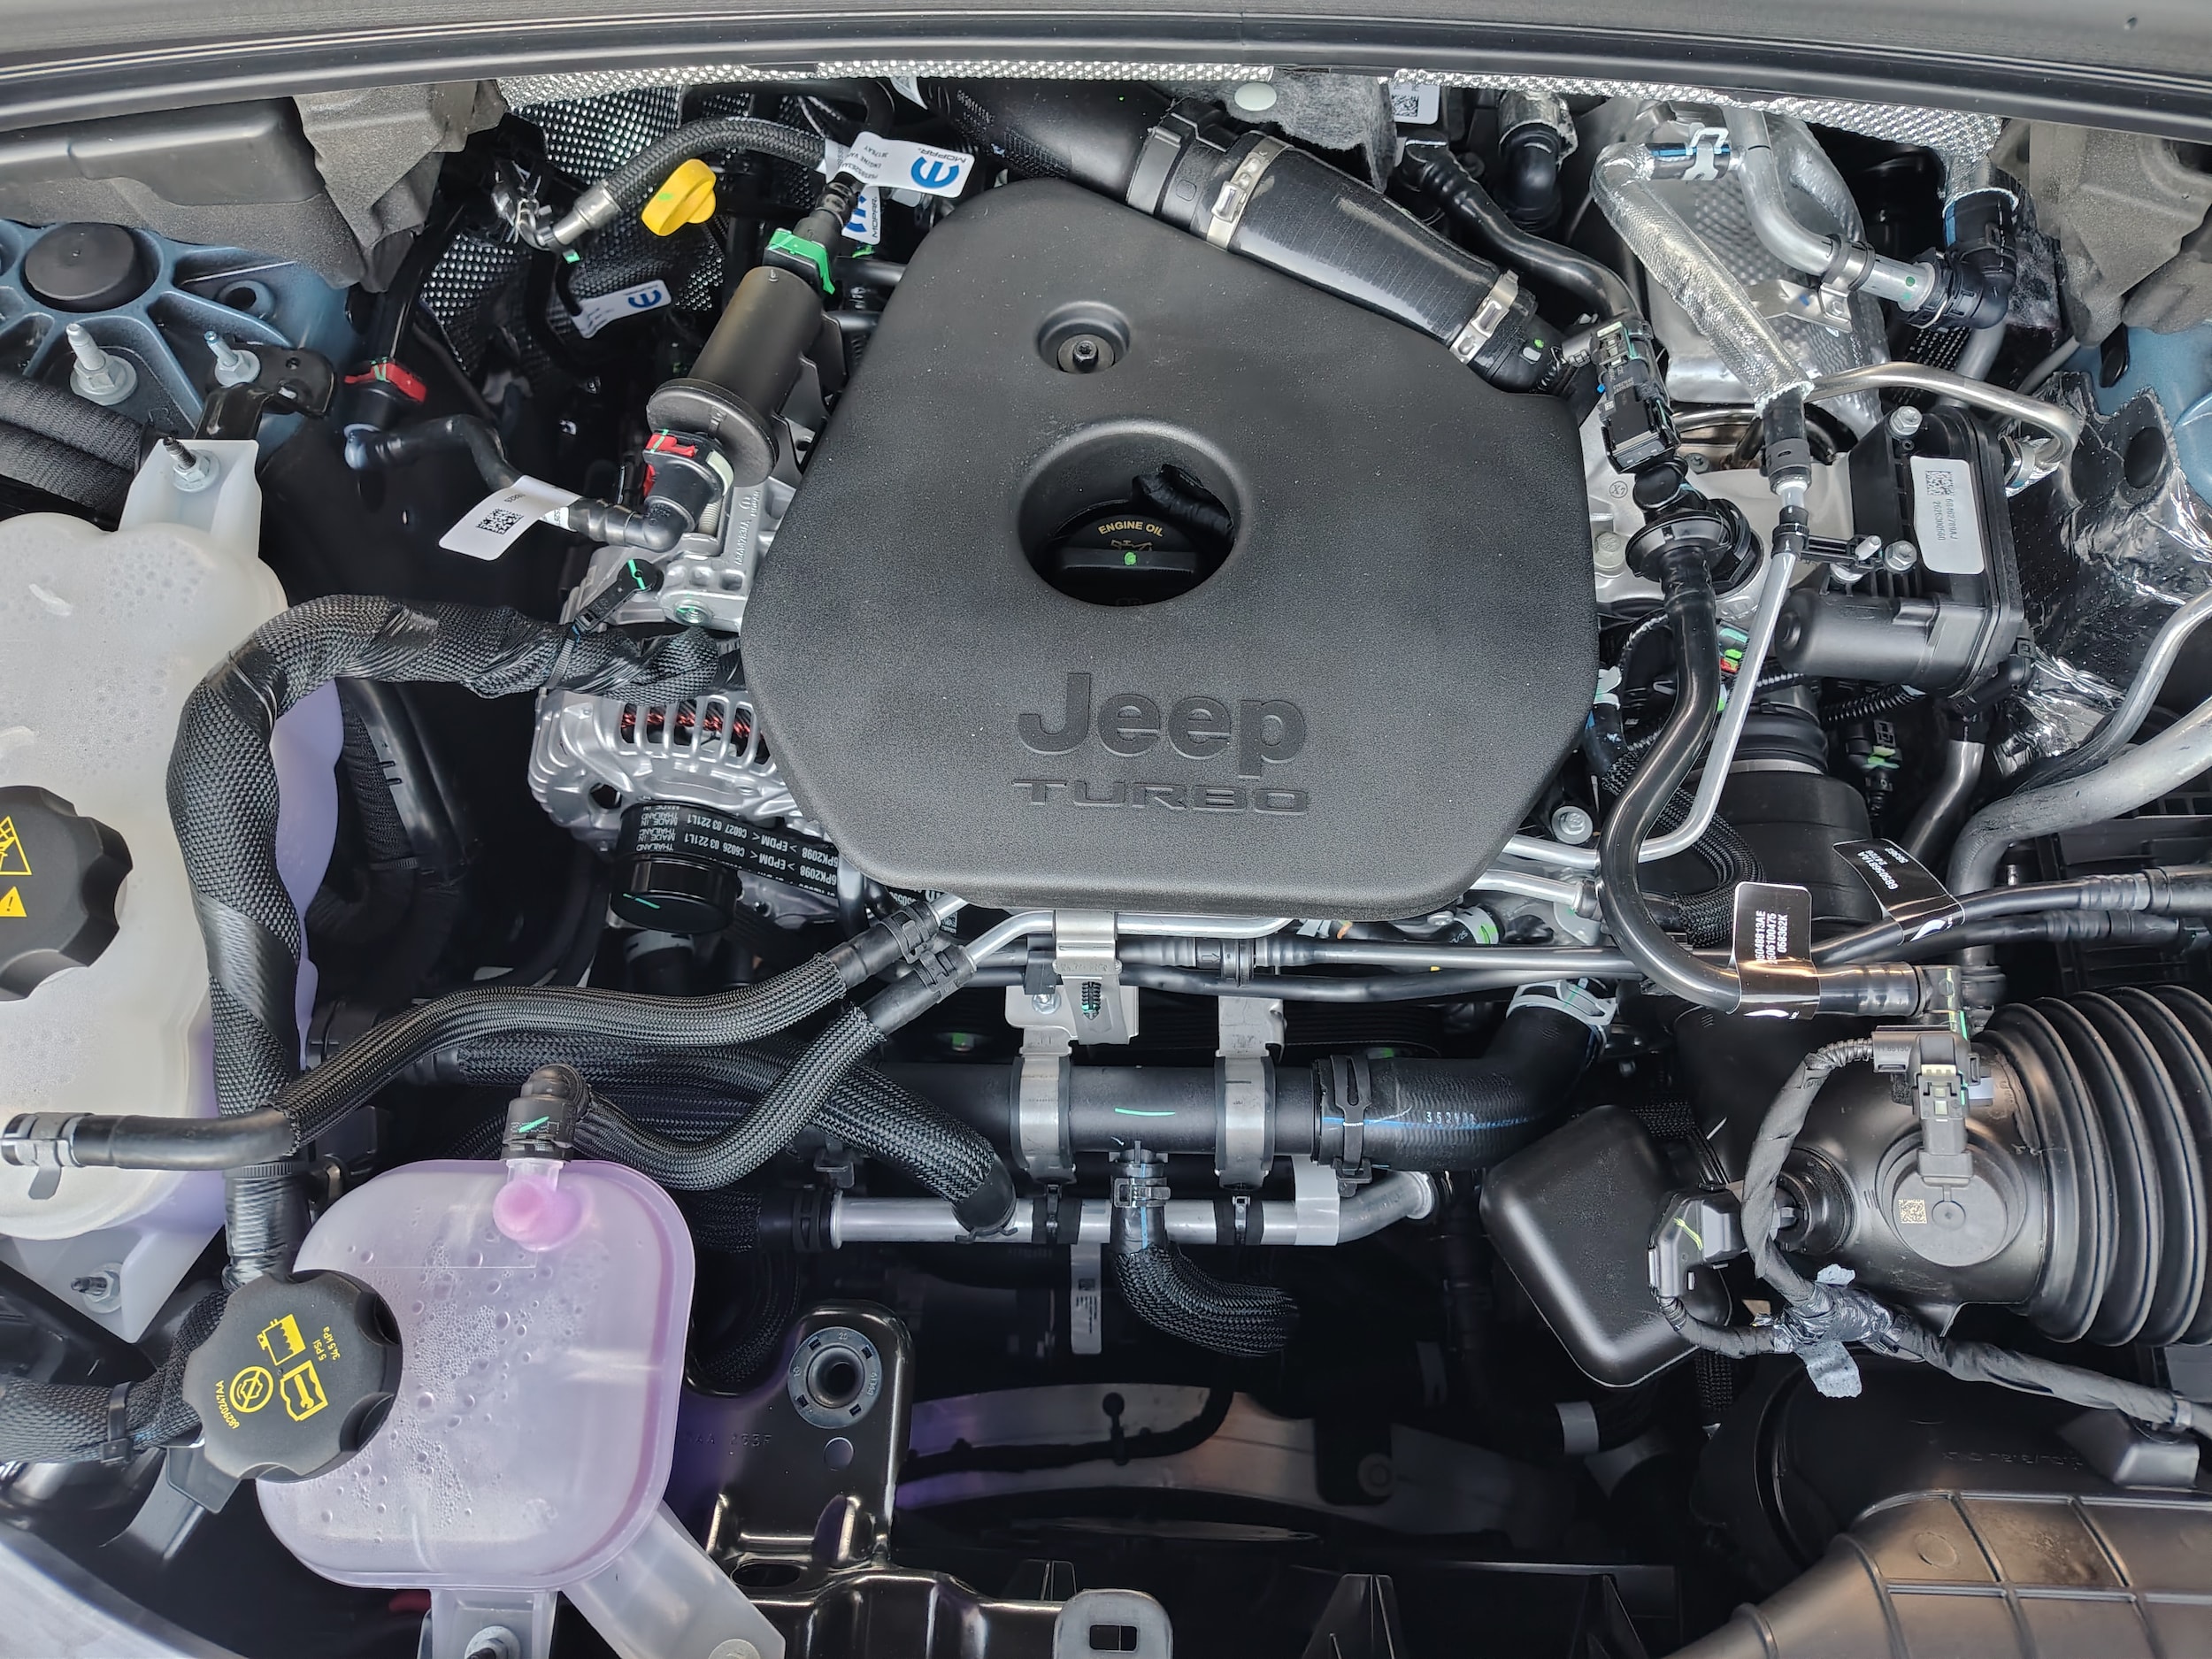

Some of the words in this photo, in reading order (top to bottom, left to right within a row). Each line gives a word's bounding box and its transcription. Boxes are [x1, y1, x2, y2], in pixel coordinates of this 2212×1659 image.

[1098, 520, 1143, 534] ENGINE
[1145, 524, 1164, 537] OIL
[1018, 672, 1306, 779] Jeep
[1012, 778, 1309, 815] TURBO
[650, 833, 676, 842] MADE
[725, 824, 748, 839] C6027
[722, 841, 745, 857] C6026
[802, 847, 839, 868] 6PK2098
[799, 864, 837, 887] 6PK2098
[323, 1326, 335, 1344] kPa
[312, 1339, 326, 1354] PSI
[327, 1343, 341, 1361] 34.5
[318, 1353, 327, 1362] 5
[215, 1379, 240, 1430] 68290247AA
